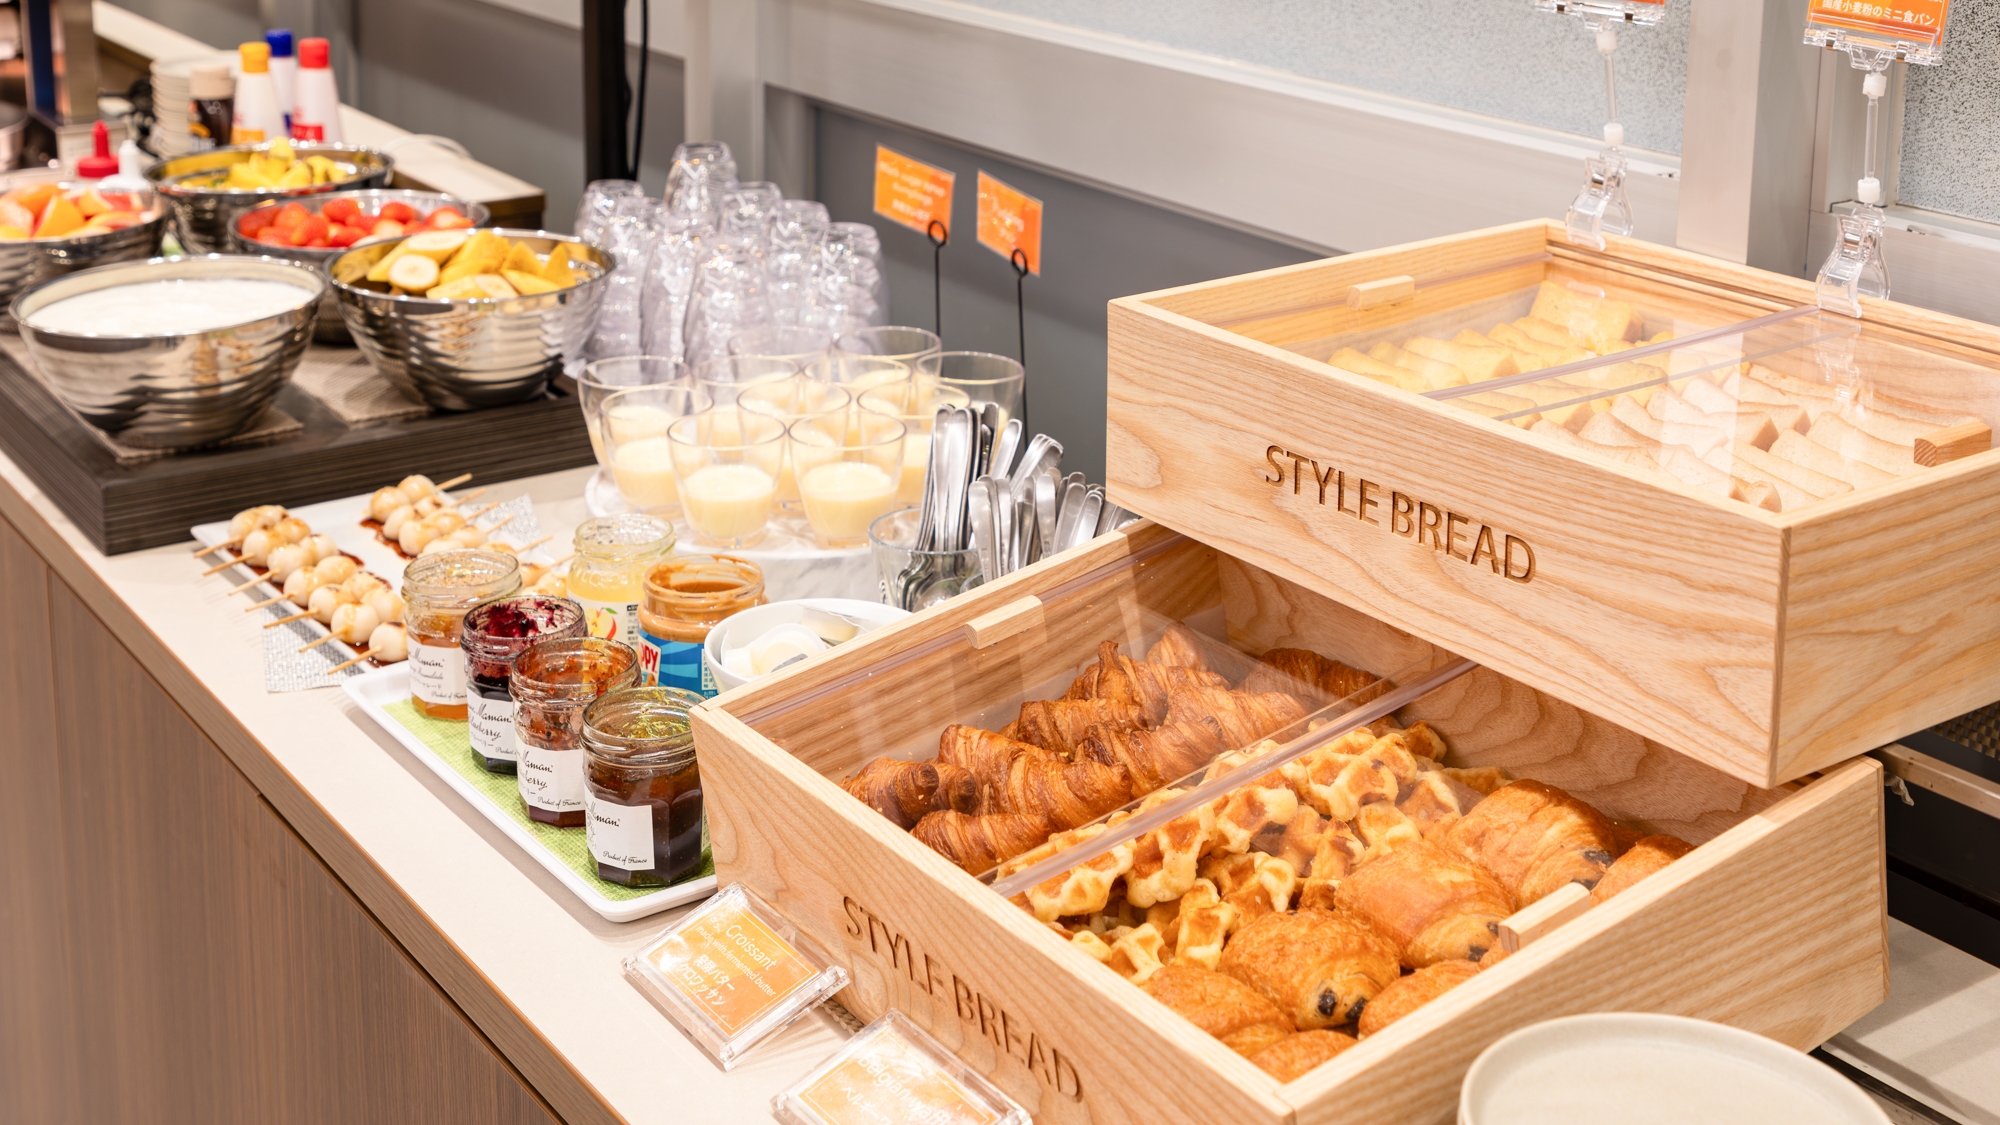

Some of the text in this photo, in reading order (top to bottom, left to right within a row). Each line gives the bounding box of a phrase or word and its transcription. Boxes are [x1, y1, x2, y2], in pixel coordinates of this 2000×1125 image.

[1822, 0, 1935, 26] 国産小麦粉のミニ食パン
[1265, 445, 1536, 584] STYLE BREAD
[603, 851, 620, 861] Product
[628, 856, 647, 864] France
[696, 926, 777, 997] made with fermented butter
[726, 924, 778, 971] Croissant
[676, 963, 726, 1005] クロワッサン
[693, 953, 736, 991] 発酵バター
[844, 896, 1083, 1104] STYLE BREAD
[857, 1053, 952, 1125] Belgian waff
